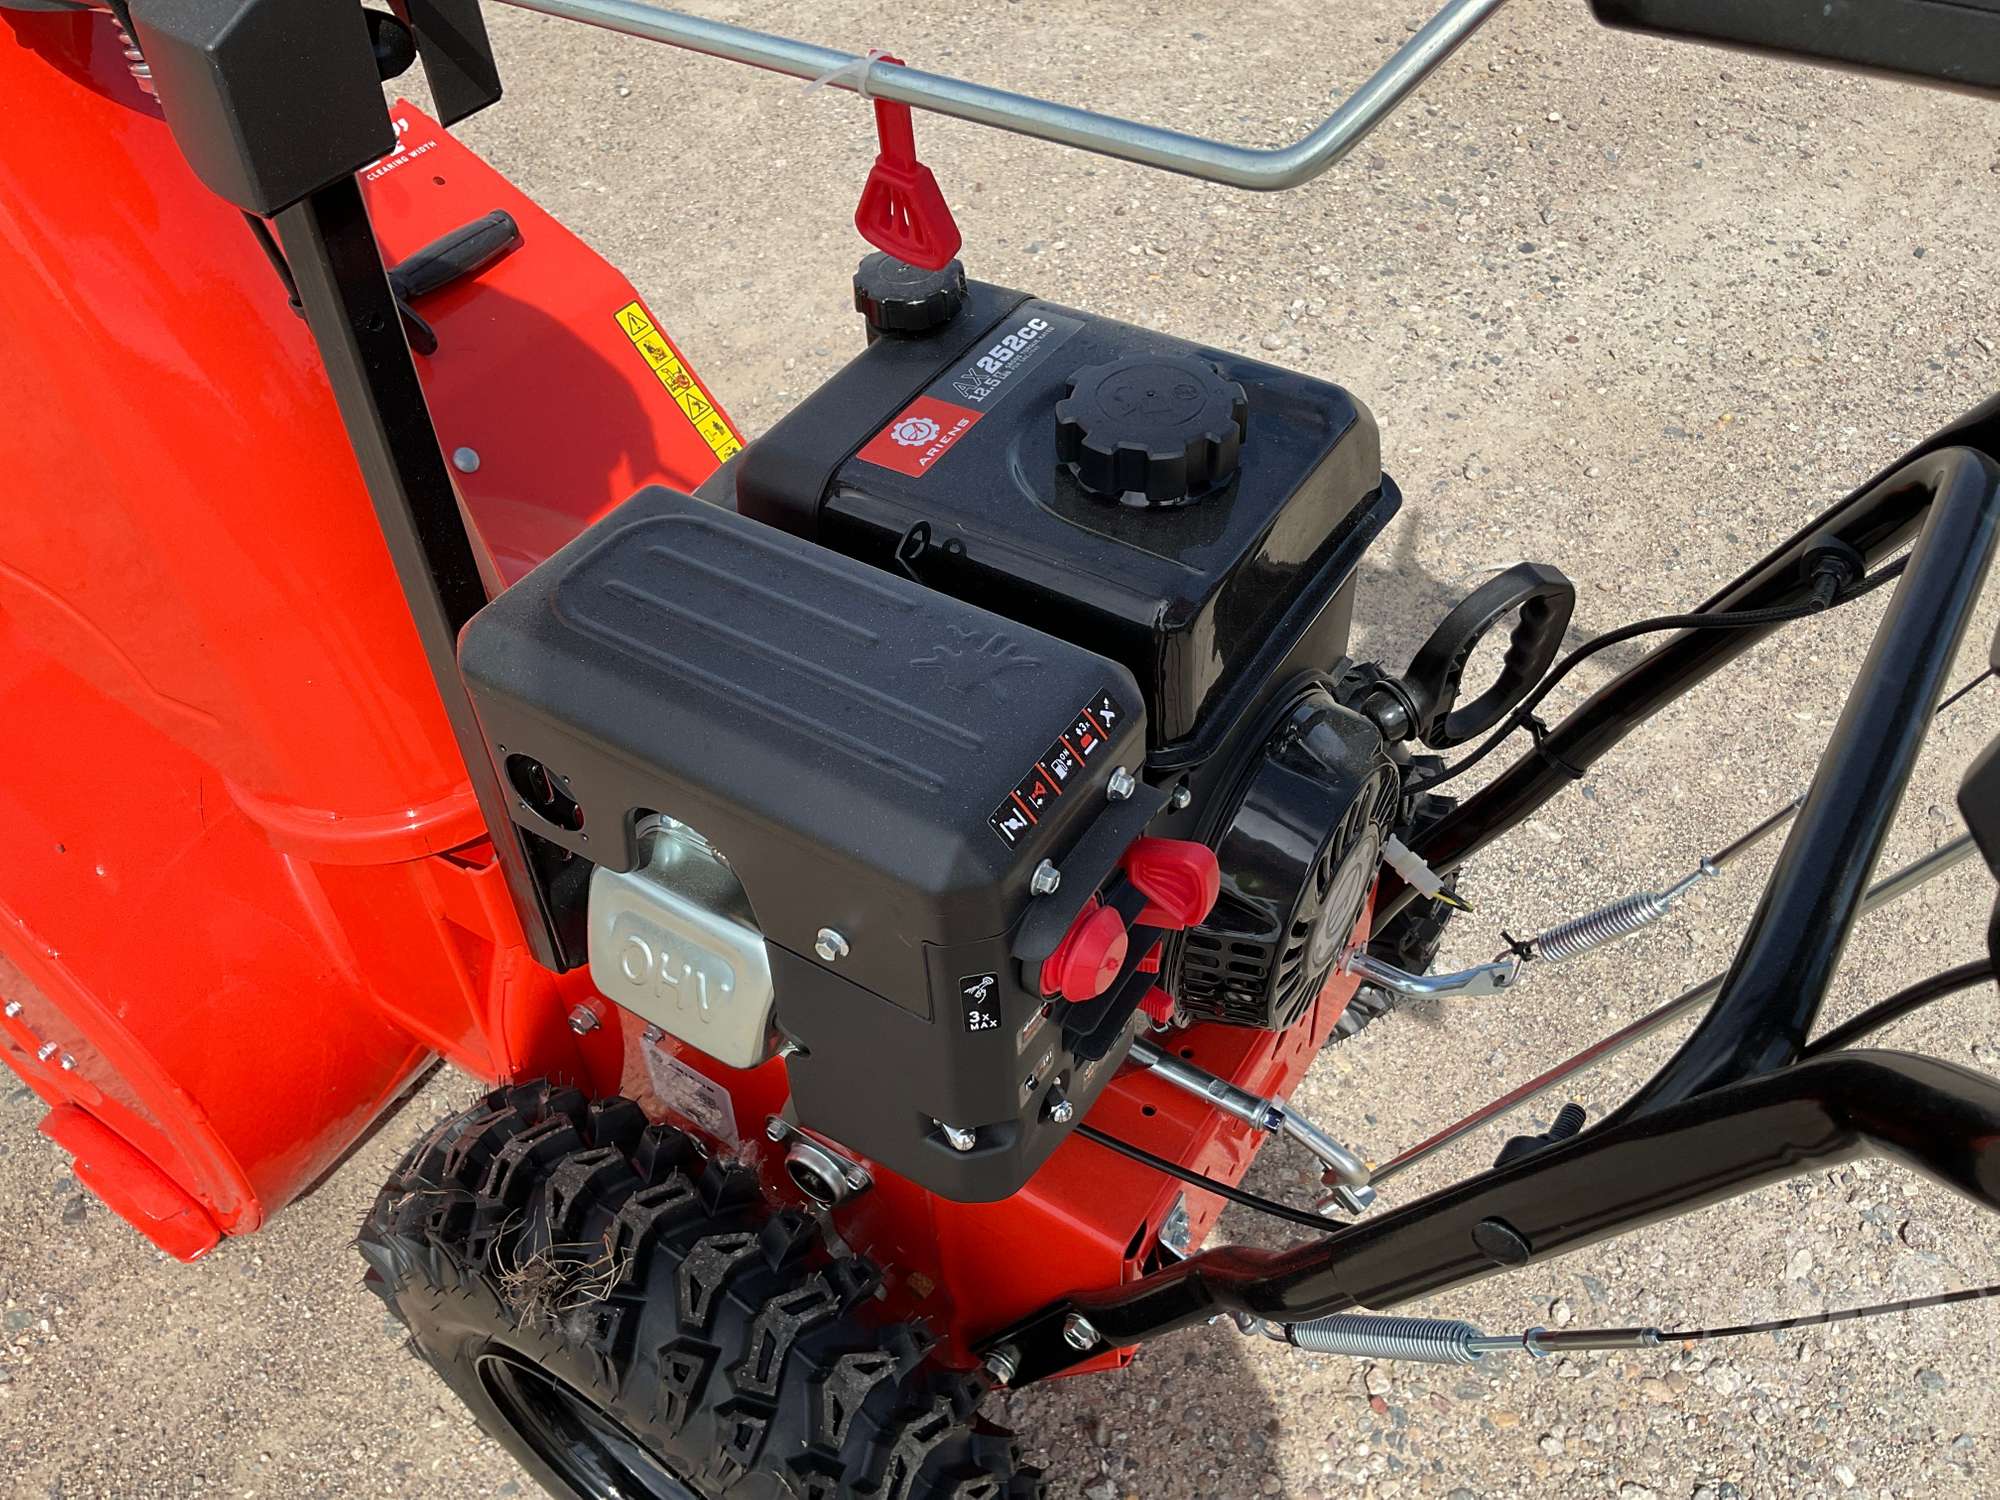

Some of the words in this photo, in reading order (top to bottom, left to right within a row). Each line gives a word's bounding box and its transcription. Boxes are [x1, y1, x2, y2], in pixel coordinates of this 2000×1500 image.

[366, 156, 409, 181] CLEARING
[408, 140, 438, 158] WIDTH
[952, 367, 989, 398] AX
[976, 318, 1048, 374] 252cc
[968, 377, 1001, 403] 12.5
[918, 418, 970, 466] ARIENS
[1060, 748, 1070, 760] ON
[622, 934, 733, 1023] OHV
[970, 1019, 998, 1031] MAX
